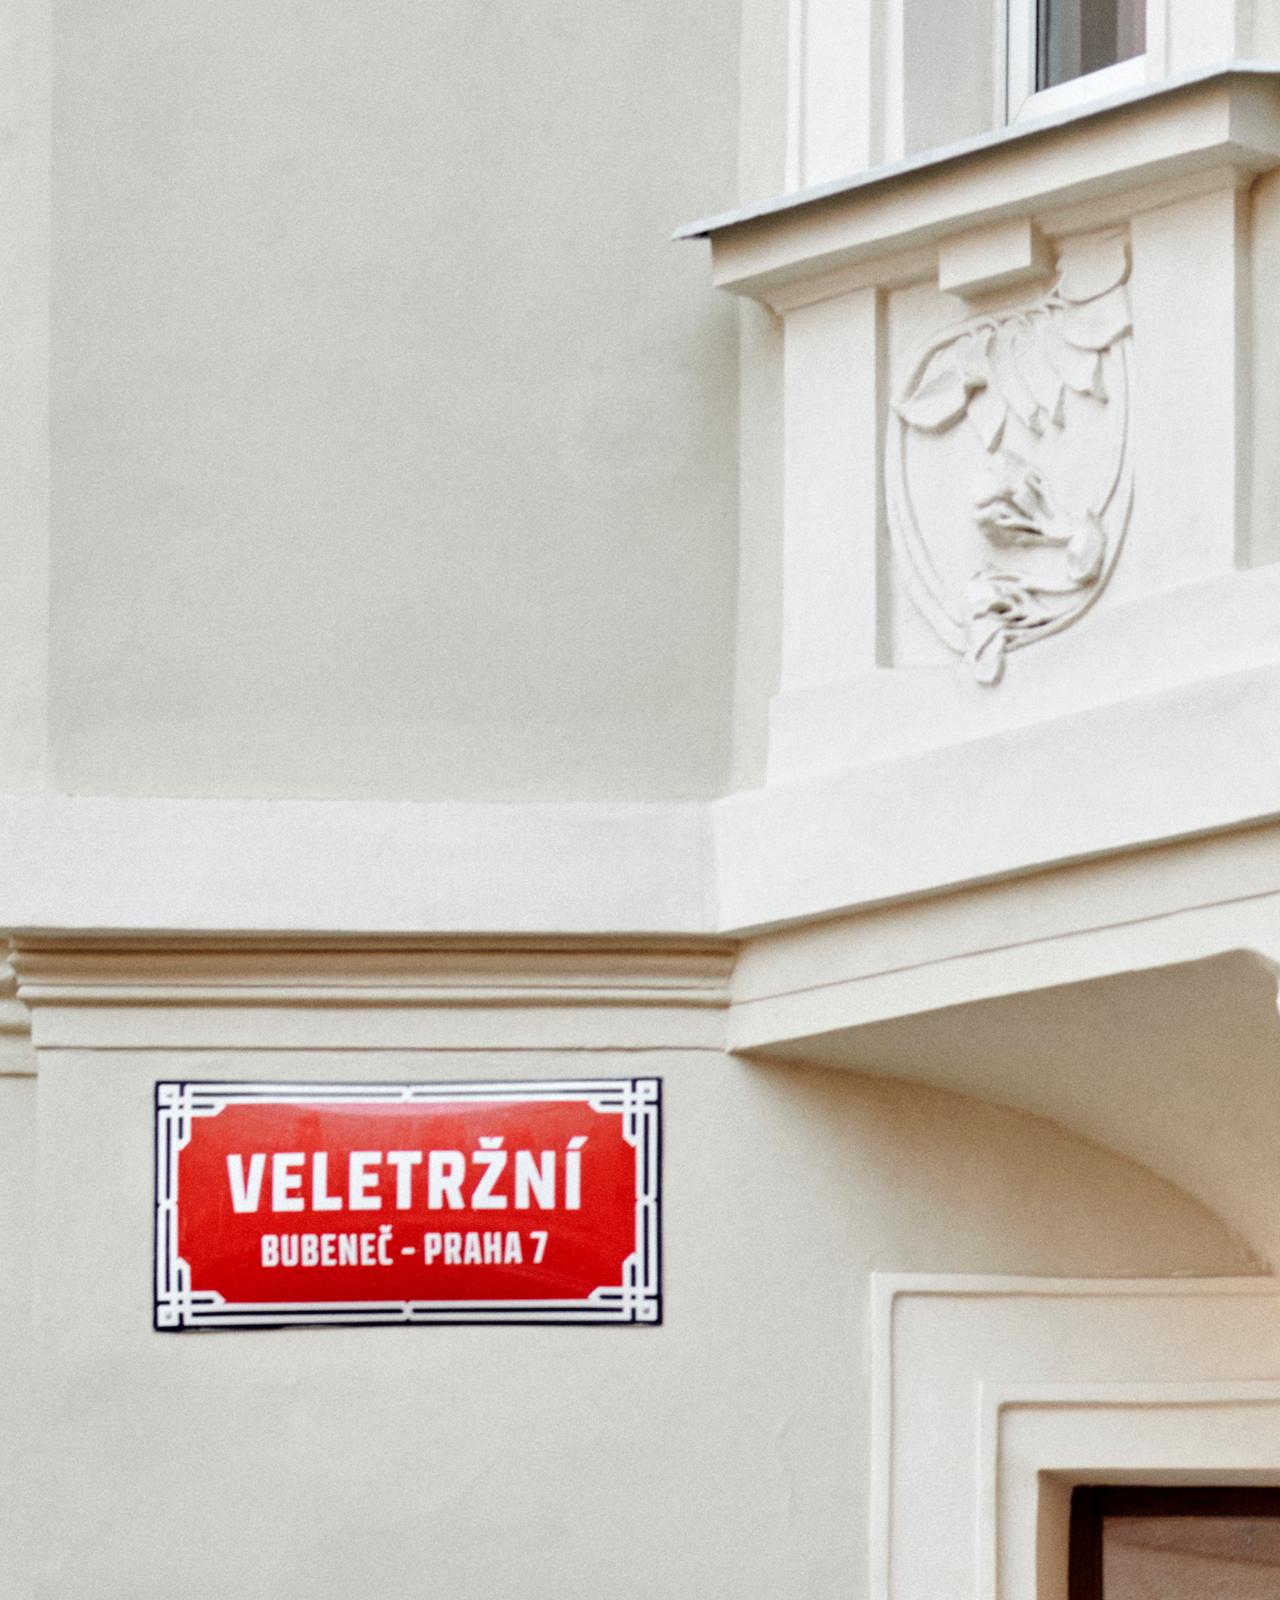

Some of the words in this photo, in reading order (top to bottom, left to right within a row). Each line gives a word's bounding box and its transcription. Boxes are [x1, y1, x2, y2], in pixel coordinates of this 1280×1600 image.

[226, 1136, 588, 1214] VELETRŽNÍ
[261, 1225, 393, 1267] BUBENEČ
[424, 1231, 523, 1265] PRAHA
[530, 1230, 548, 1265] 7
